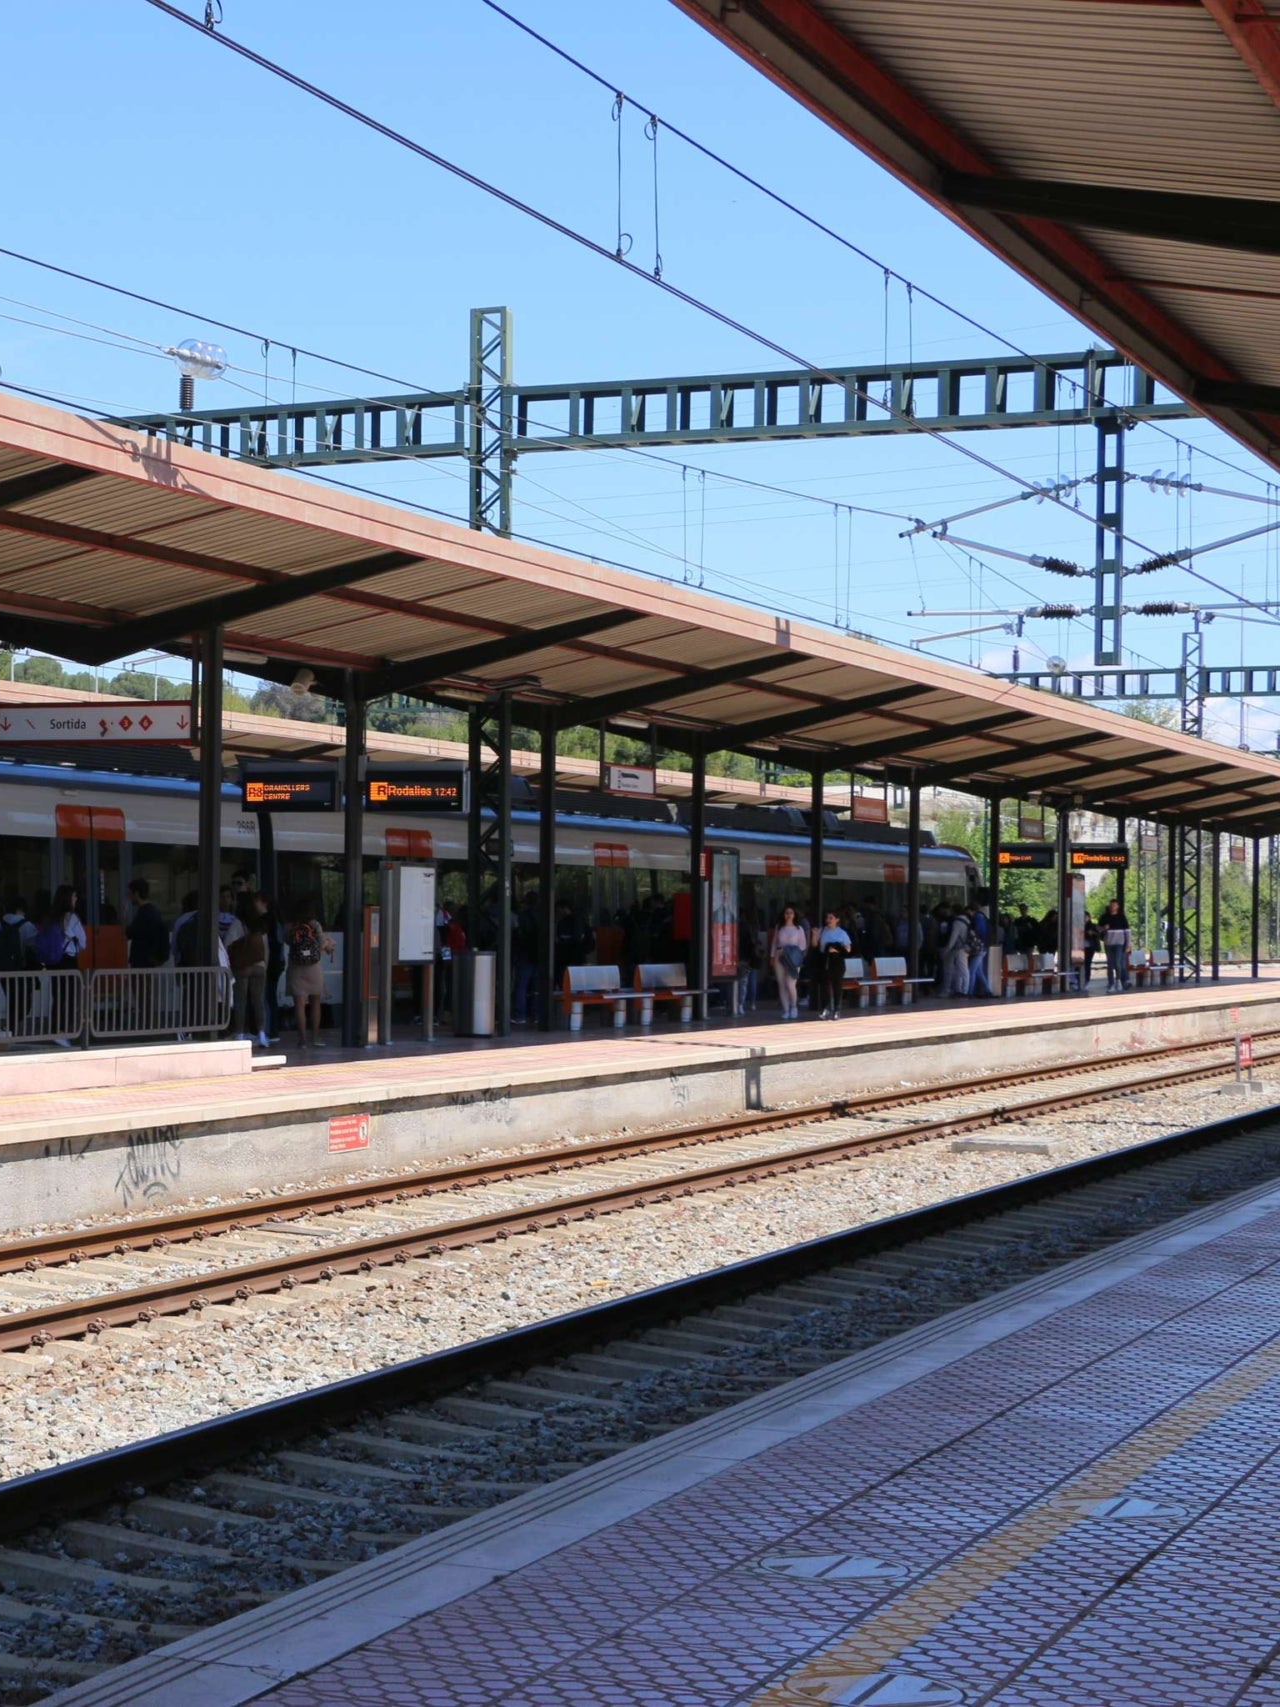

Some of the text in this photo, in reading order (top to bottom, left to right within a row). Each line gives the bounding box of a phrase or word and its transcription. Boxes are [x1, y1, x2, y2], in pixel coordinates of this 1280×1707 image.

[49, 718, 87, 730] Sortida
[377, 785, 457, 796] R Rodalies 12:42
